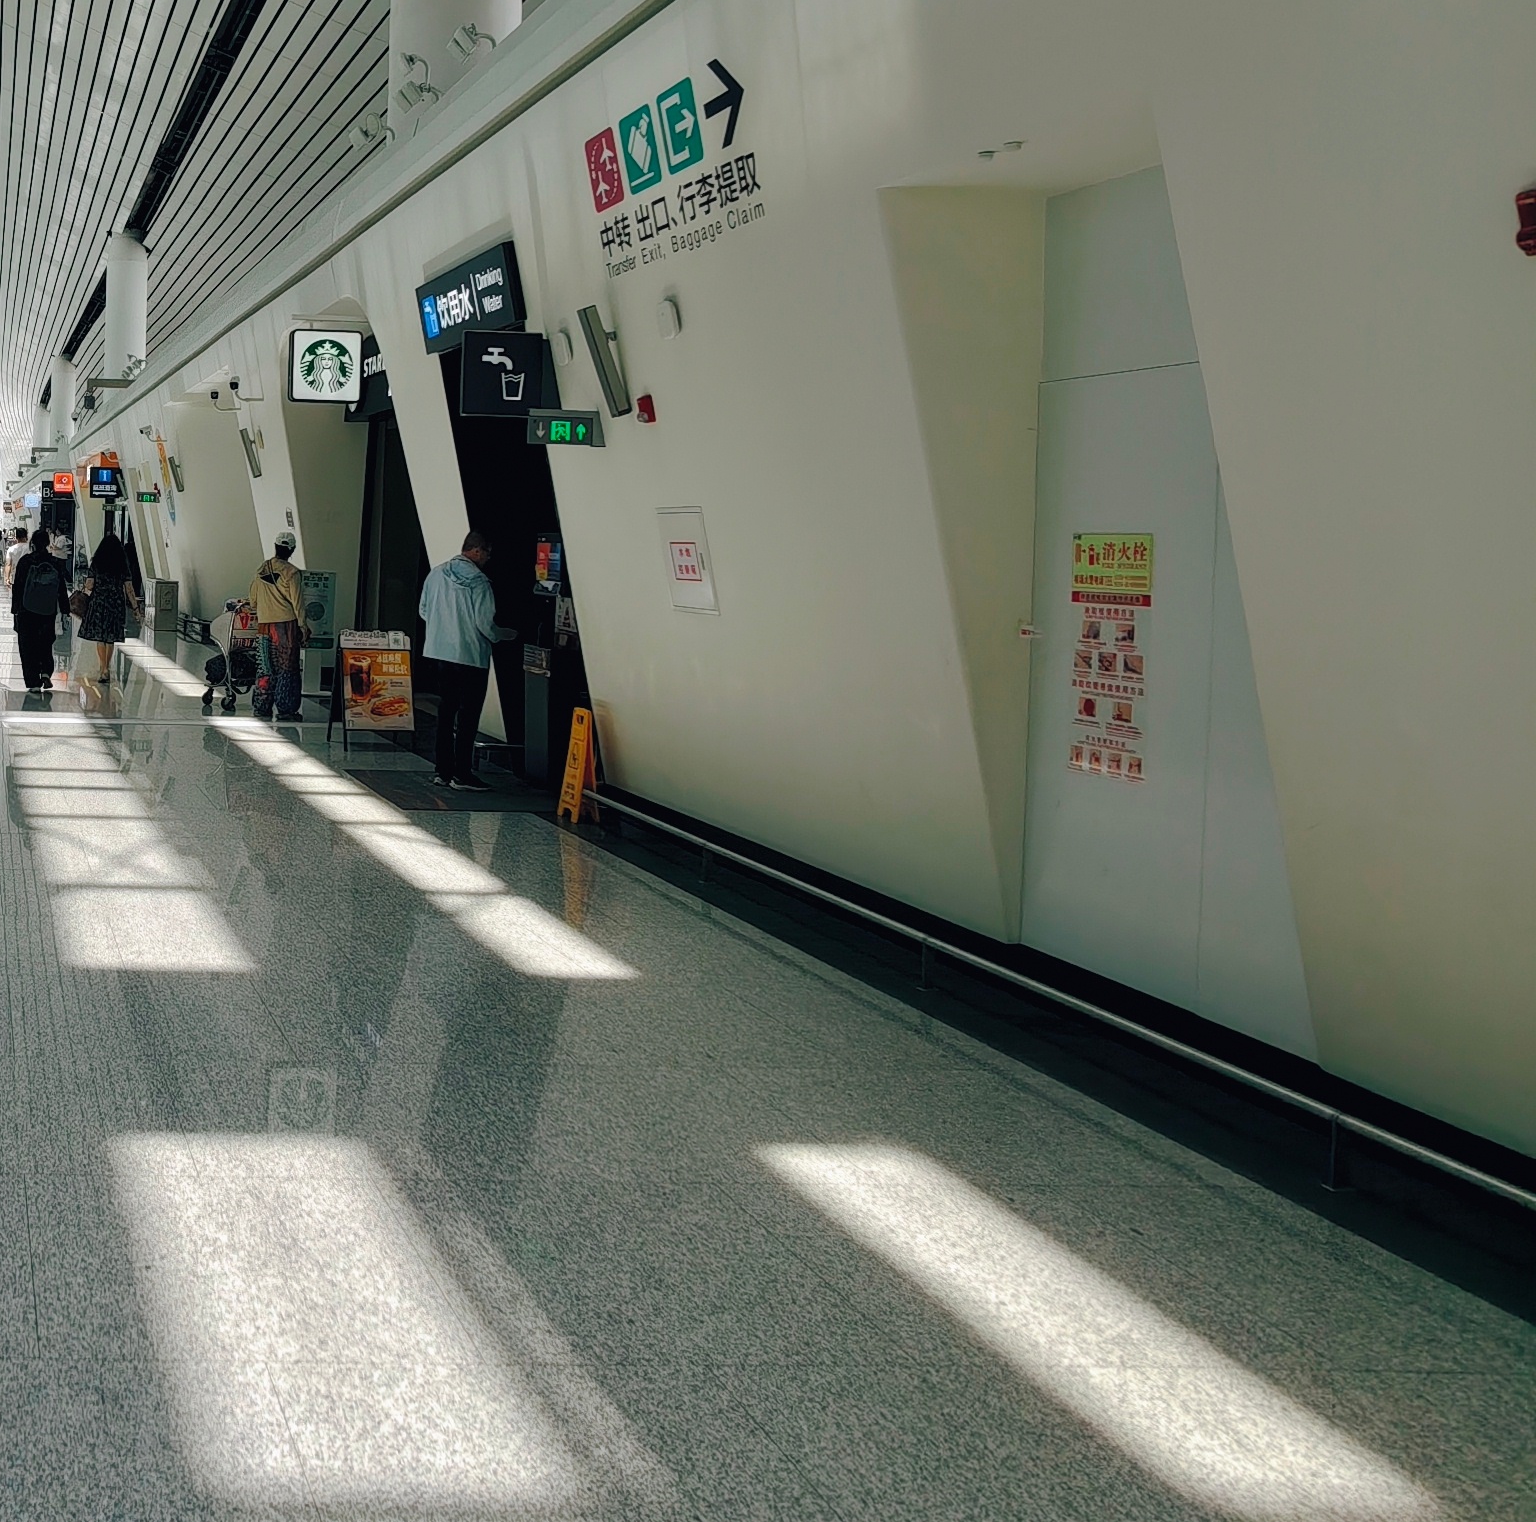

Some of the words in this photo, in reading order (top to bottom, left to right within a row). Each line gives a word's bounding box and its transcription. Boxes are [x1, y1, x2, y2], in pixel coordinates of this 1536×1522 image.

[600, 213, 633, 258] 中转
[634, 152, 761, 243] 出口、行李提取
[606, 255, 637, 280] Transfer
[641, 243, 666, 266] Exit,
[670, 220, 723, 253] Baggage
[726, 202, 766, 230] Claim
[475, 266, 503, 292] Drinking
[436, 283, 474, 329] 饮用水
[482, 293, 504, 315] Water
[1102, 542, 1148, 562] 消火栓
